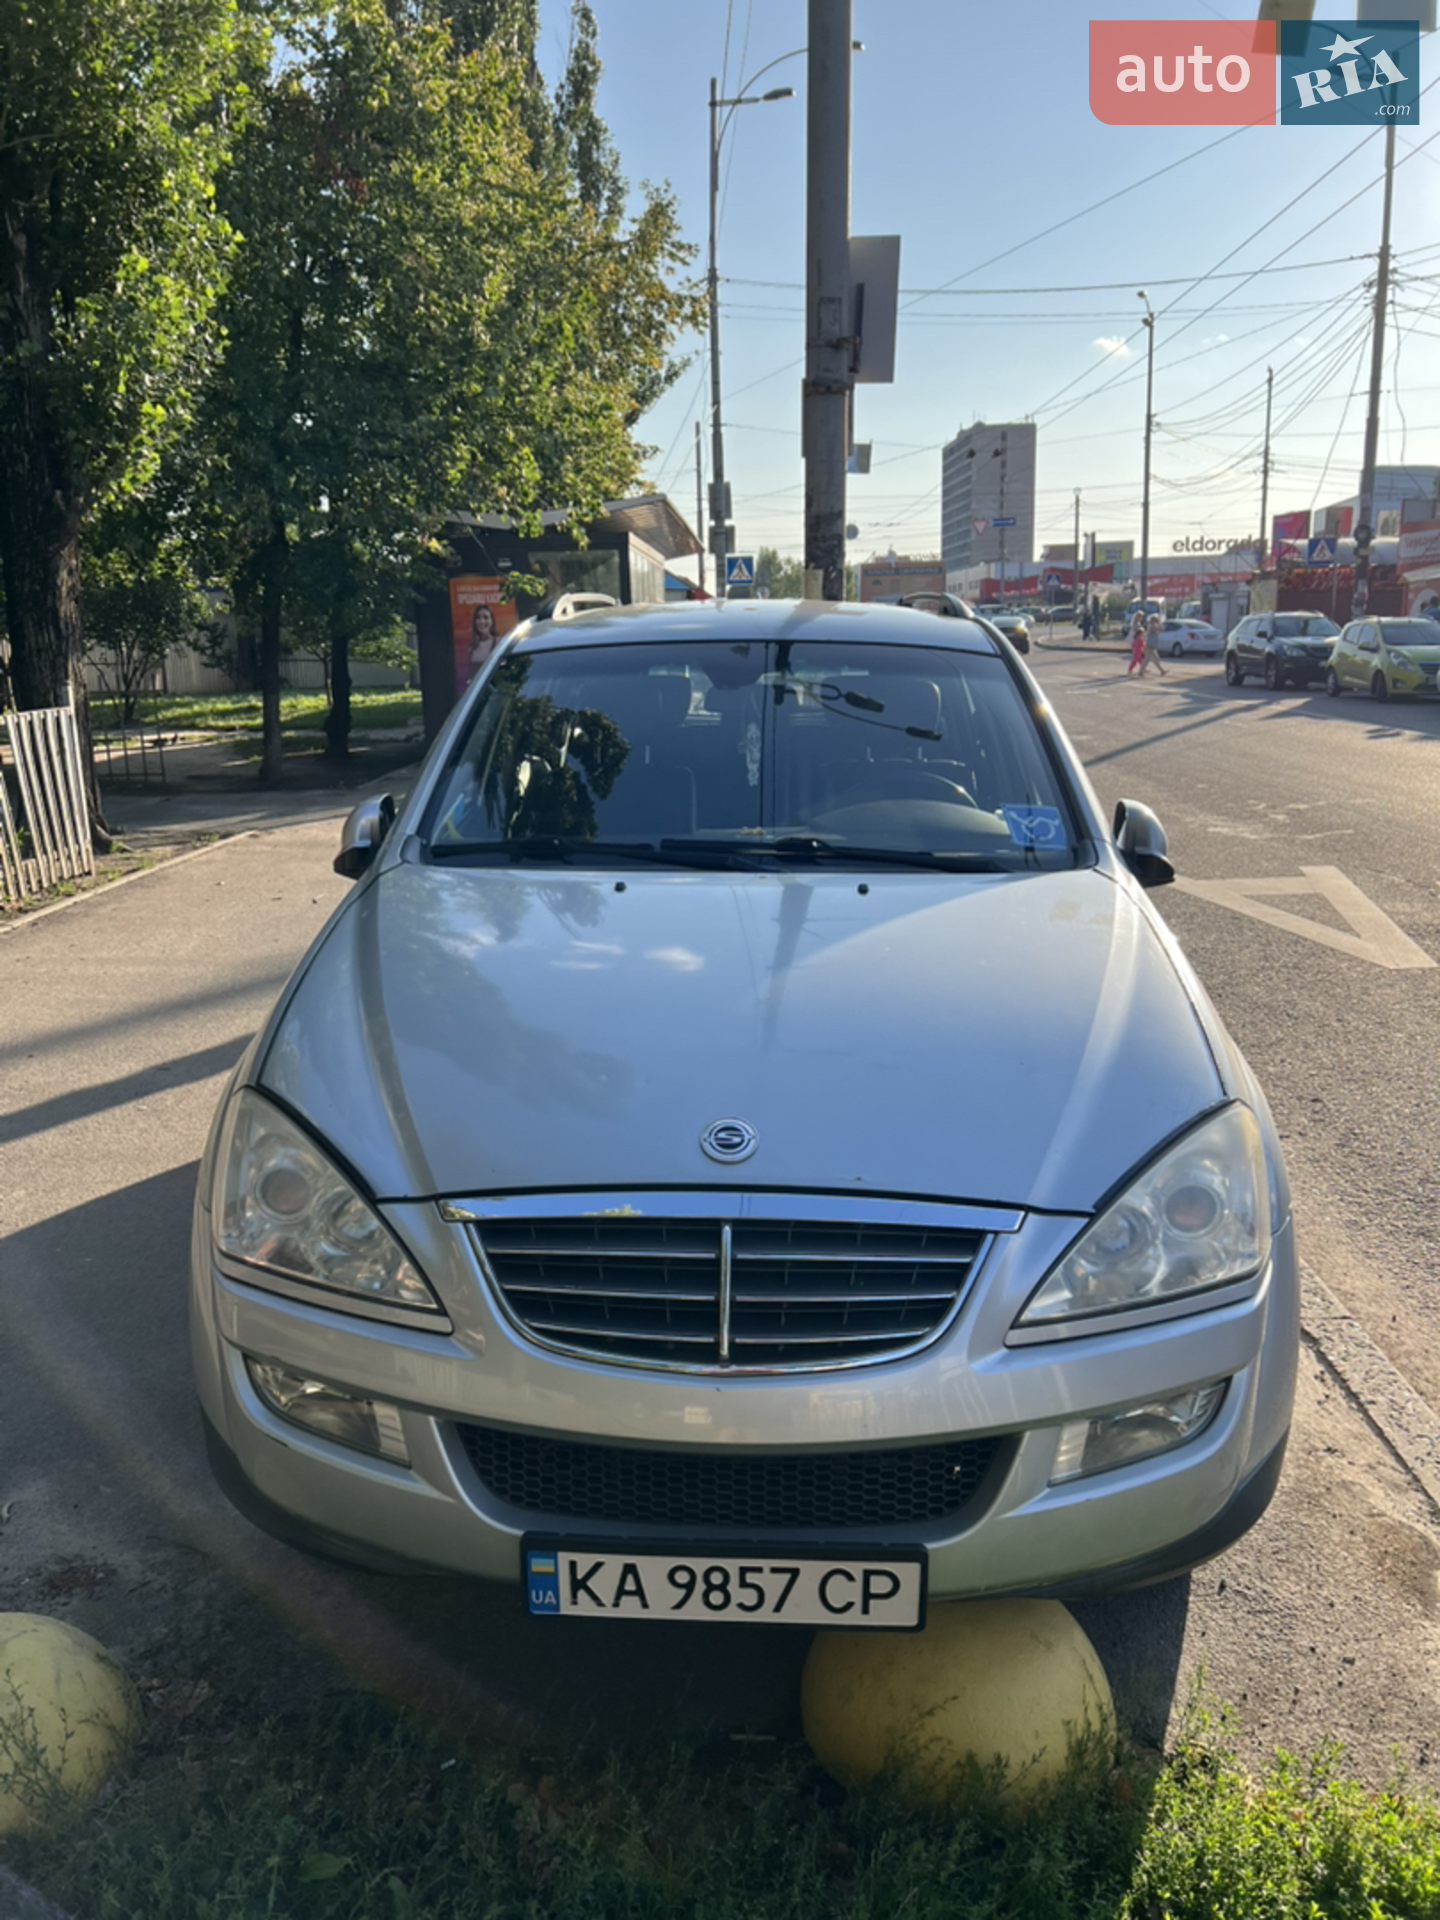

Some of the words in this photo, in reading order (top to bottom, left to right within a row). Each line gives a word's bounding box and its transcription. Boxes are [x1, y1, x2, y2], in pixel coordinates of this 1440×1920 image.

[531, 1589, 557, 1605] UA
[568, 1560, 650, 1609] KA
[667, 1565, 800, 1614] 9857
[818, 1568, 901, 1615] CP
